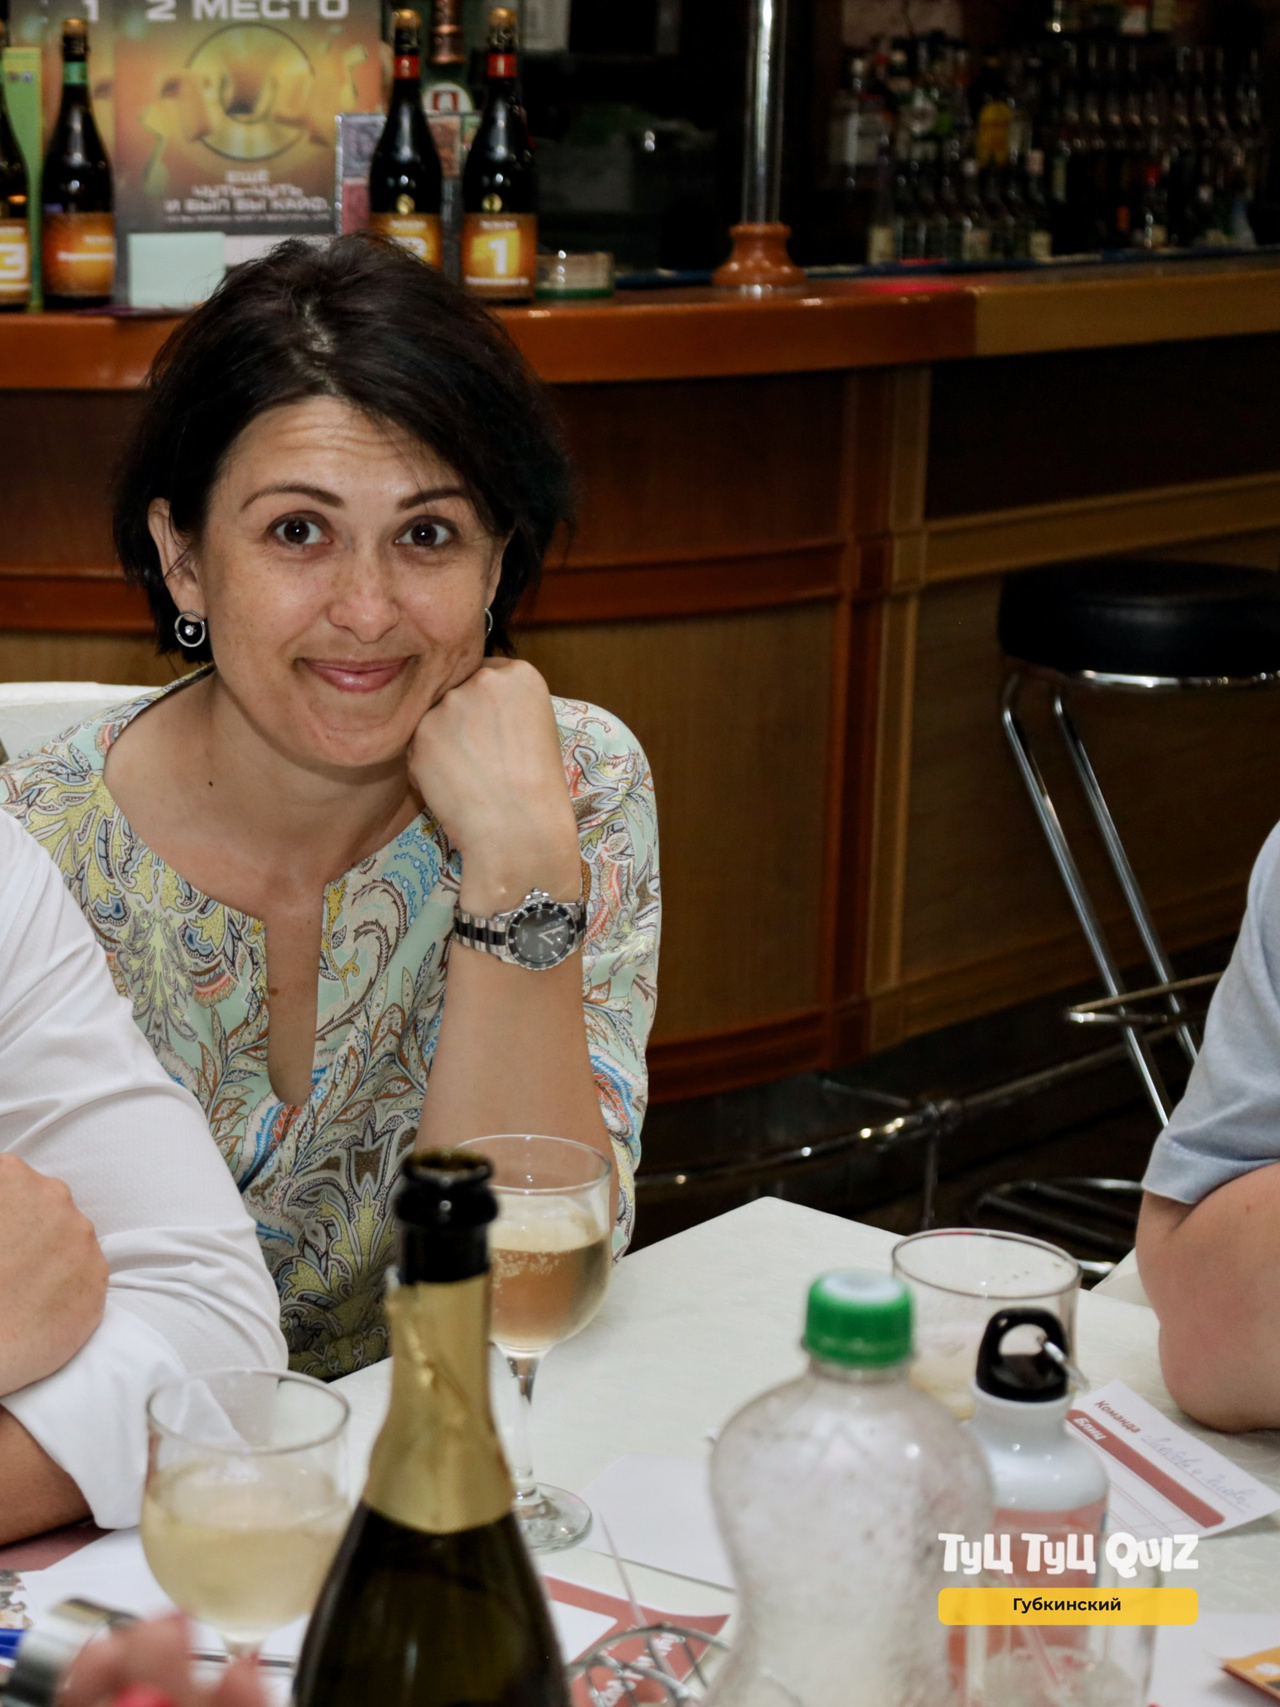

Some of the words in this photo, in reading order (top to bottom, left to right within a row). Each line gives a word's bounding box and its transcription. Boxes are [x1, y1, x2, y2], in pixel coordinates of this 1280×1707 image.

[147, 0, 176, 20] 2
[193, 0, 349, 20] МЕСТО
[488, 237, 509, 275] 1
[1073, 1416, 1108, 1441] Блиц
[1094, 1399, 1142, 1434] Команда
